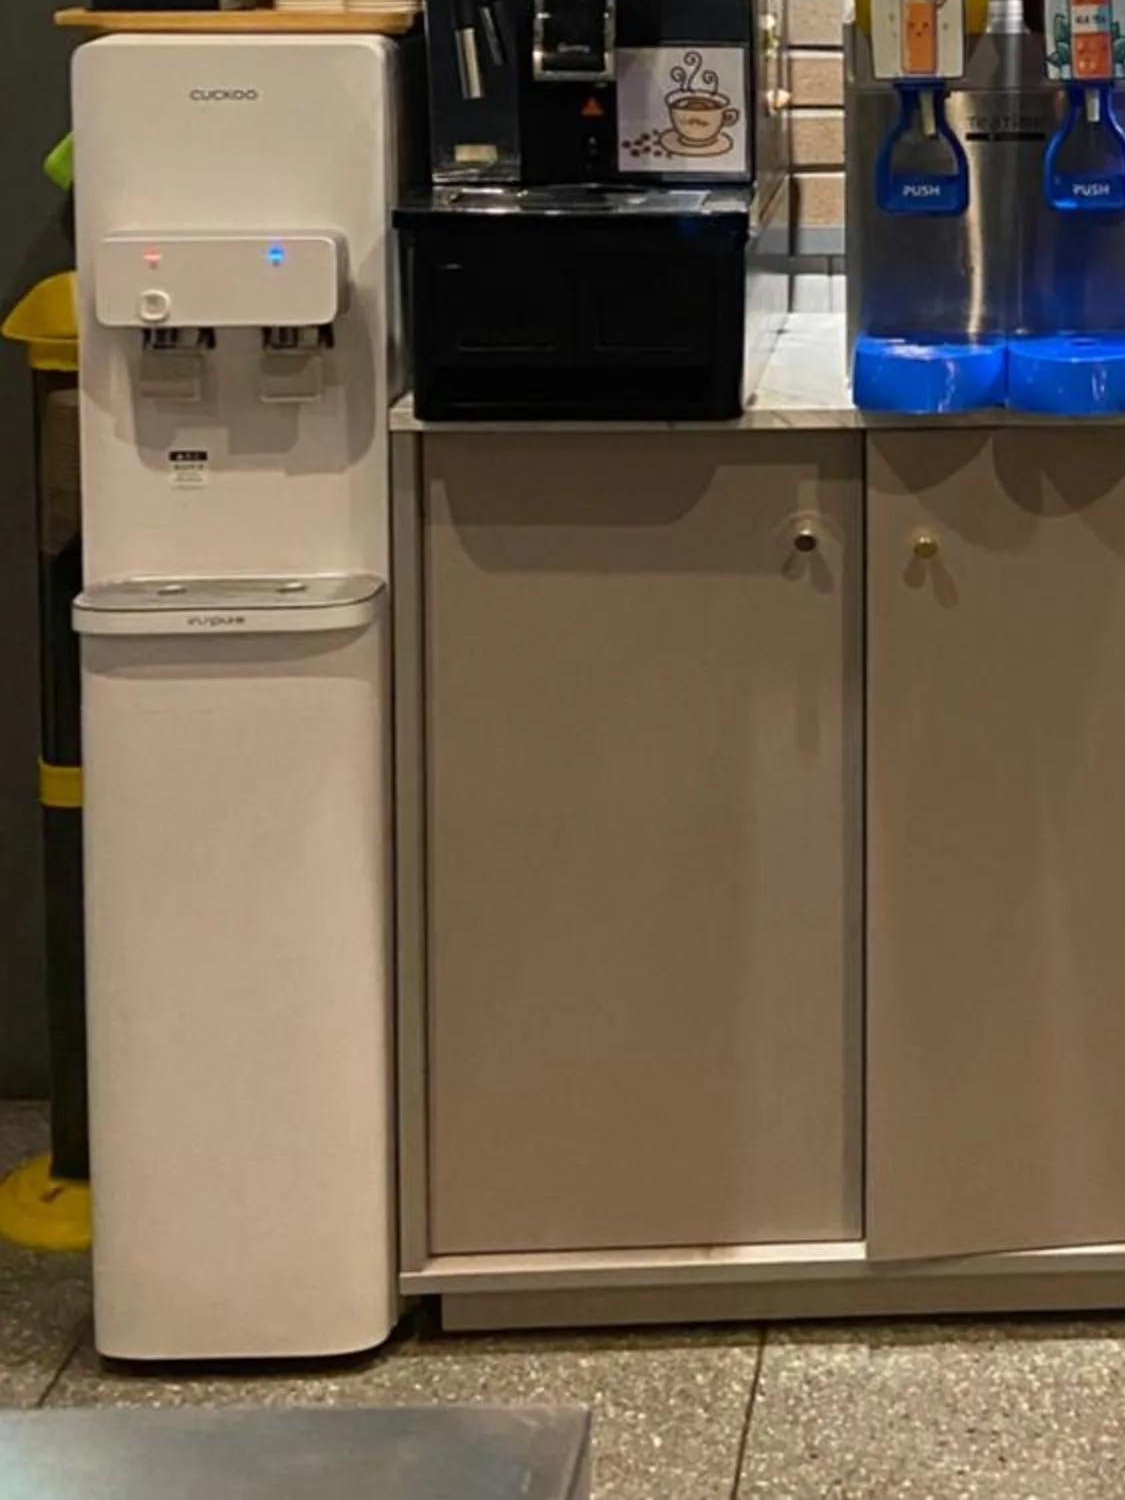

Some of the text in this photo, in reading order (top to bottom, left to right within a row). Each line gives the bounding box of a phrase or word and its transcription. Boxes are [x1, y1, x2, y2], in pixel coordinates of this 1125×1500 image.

[189, 89, 259, 101] CUCKOO
[902, 185, 941, 197] PUSH
[1072, 183, 1110, 196] PUSH
